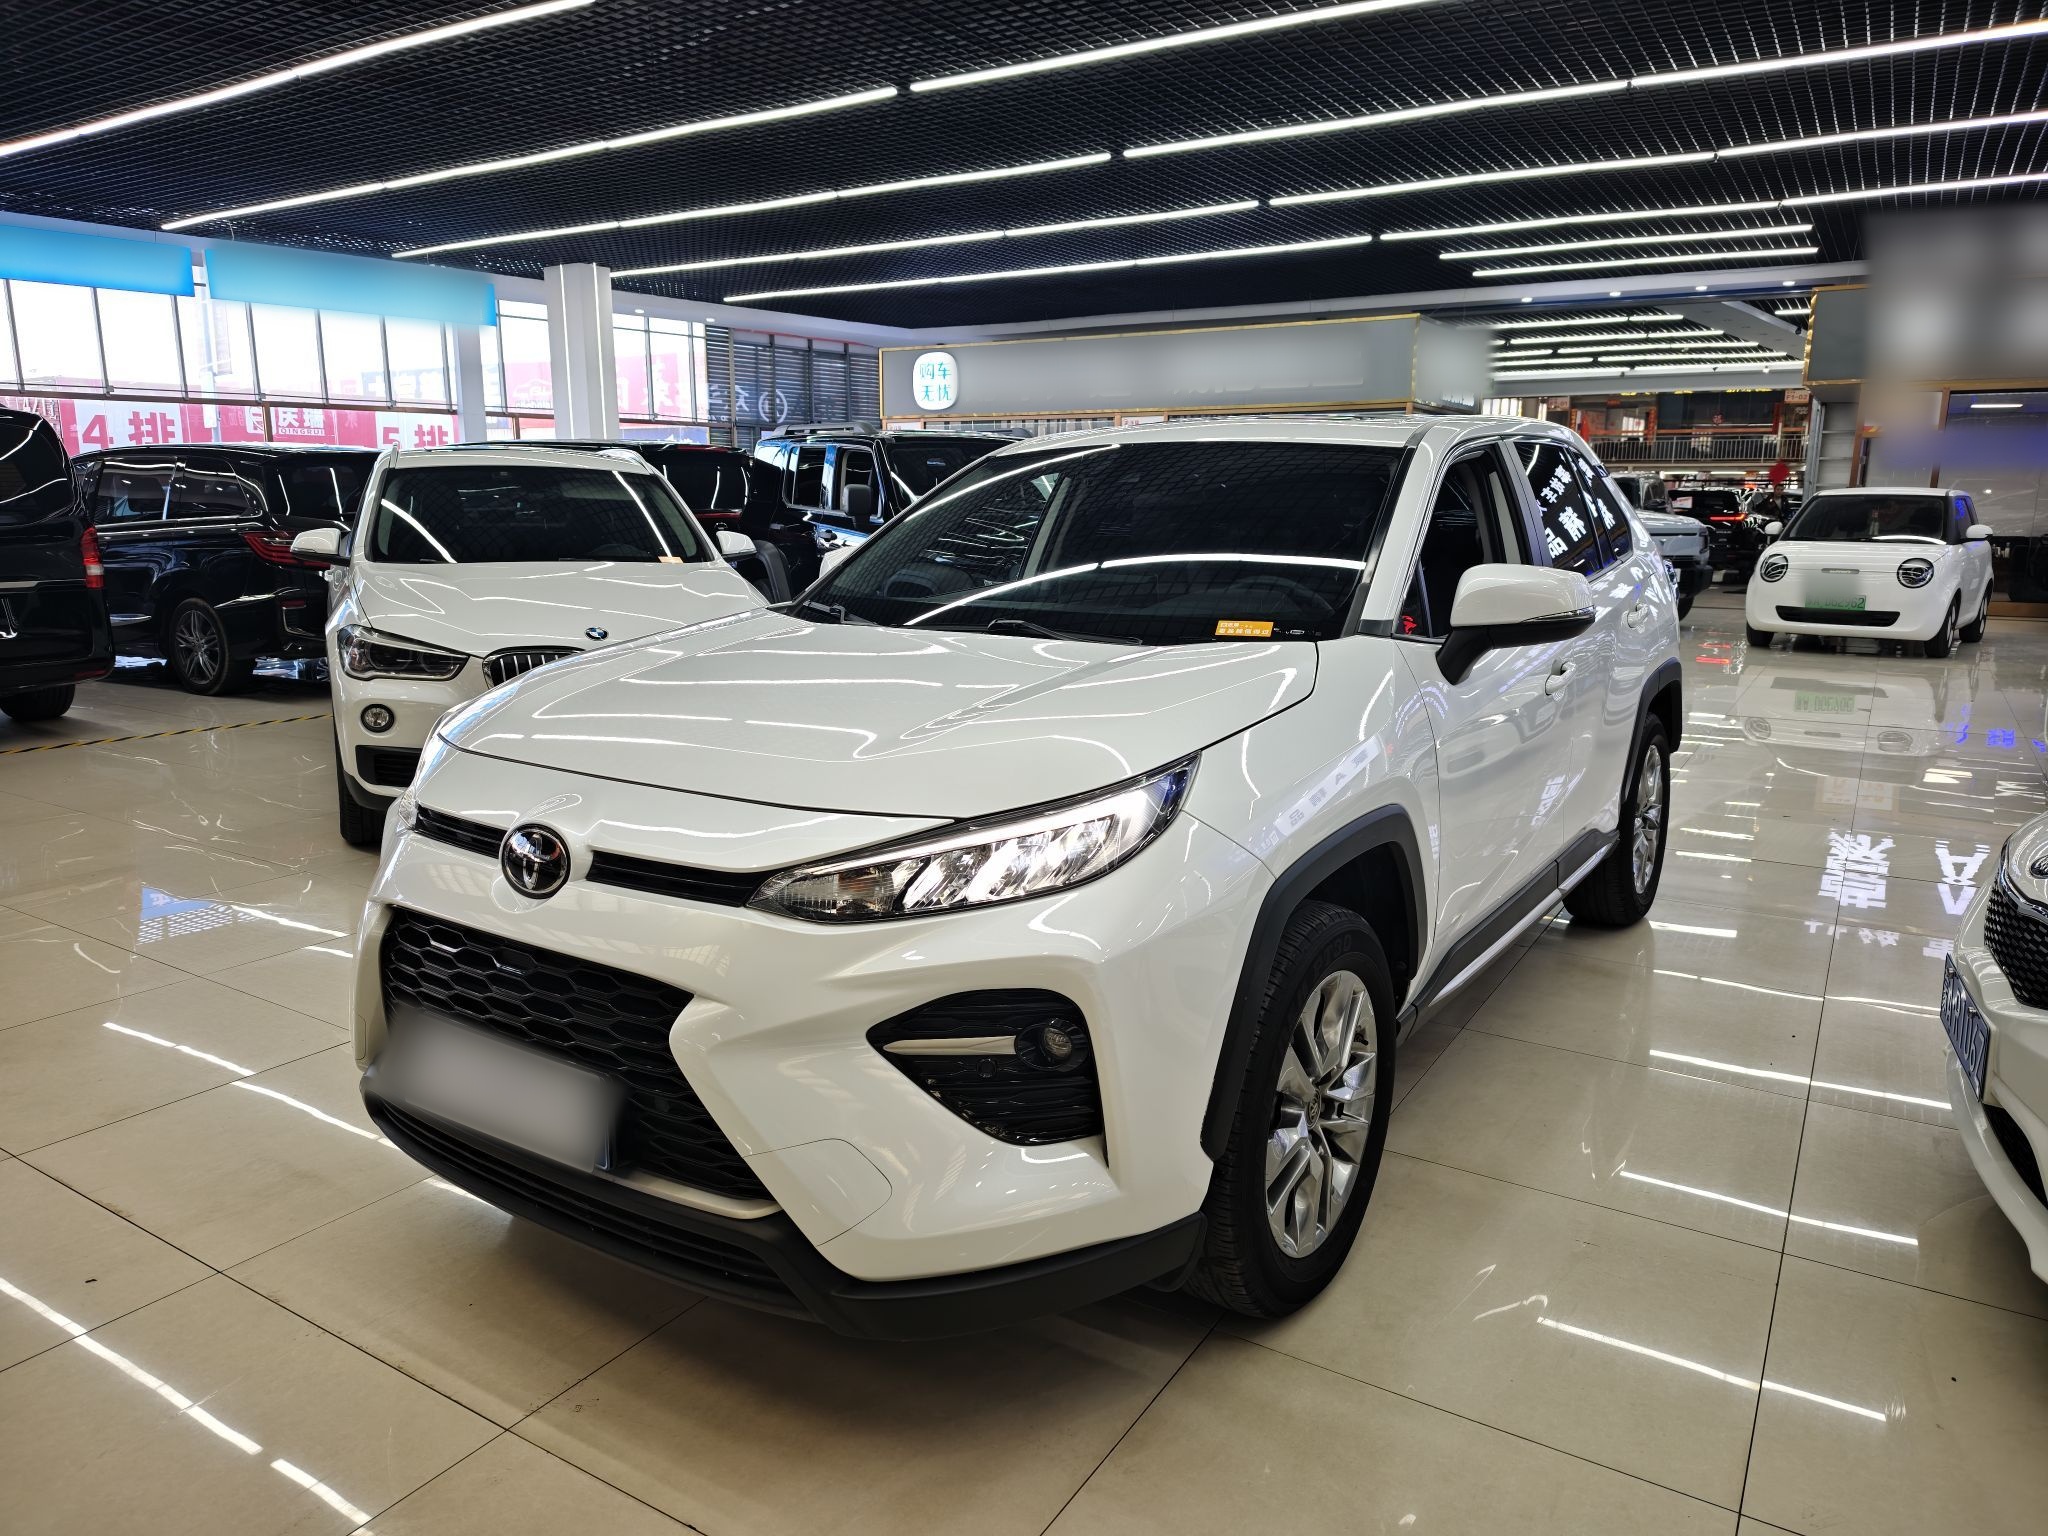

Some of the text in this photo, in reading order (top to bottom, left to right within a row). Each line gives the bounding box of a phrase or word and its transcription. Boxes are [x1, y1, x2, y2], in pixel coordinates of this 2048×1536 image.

[920, 361, 952, 380] 购车
[920, 384, 952, 402] 无忧
[279, 428, 324, 436] QINGRUI
